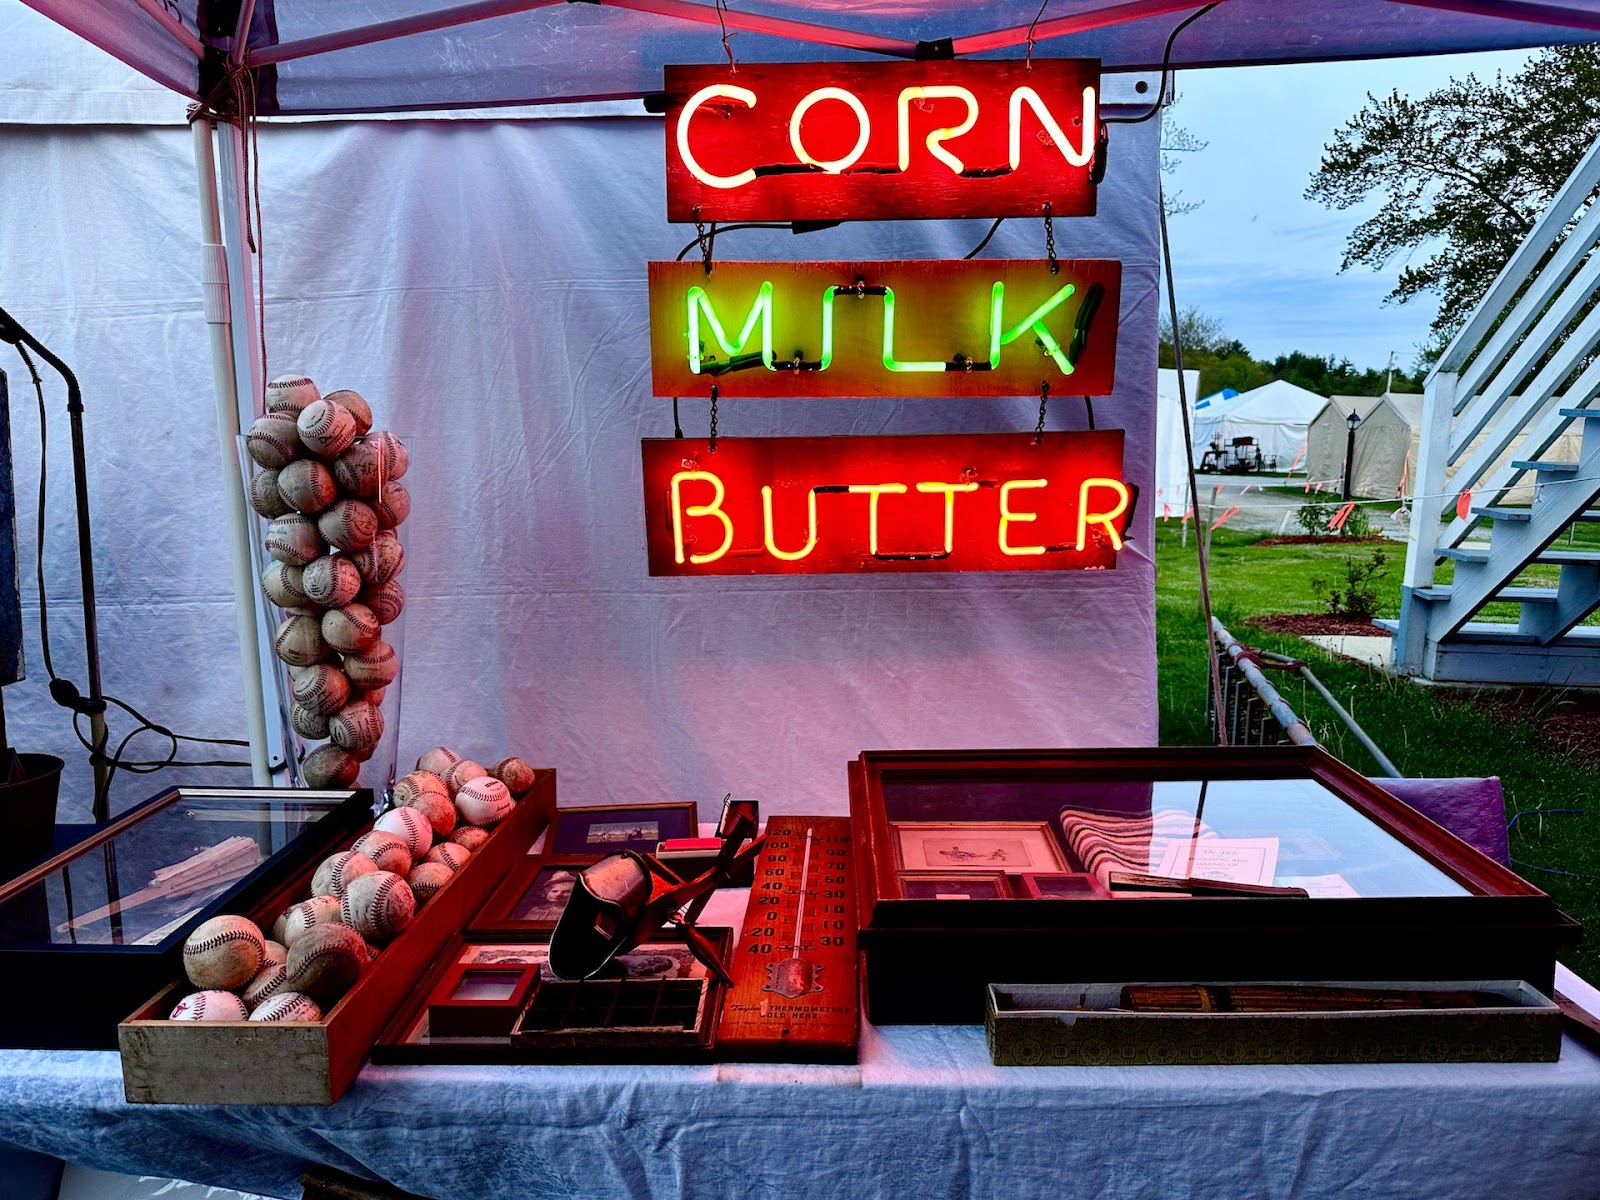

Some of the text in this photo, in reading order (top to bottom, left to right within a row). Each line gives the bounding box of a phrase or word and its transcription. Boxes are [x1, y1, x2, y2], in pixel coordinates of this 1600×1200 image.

[676, 83, 1097, 190] CORN
[686, 280, 1077, 376] MILK
[669, 470, 1130, 565] BUTTER
[826, 835, 849, 843] 110
[764, 841, 790, 849] 100
[827, 848, 846, 857] 90
[767, 854, 787, 863] 80
[827, 863, 845, 871] 70
[764, 868, 785, 877] 60
[825, 875, 845, 884] 50
[761, 881, 783, 890] 40
[823, 889, 845, 899] 30
[758, 896, 781, 906] 20
[824, 904, 845, 913] 10
[766, 911, 778, 921] 0
[823, 920, 844, 929] 10
[751, 927, 775, 937] 20
[820, 935, 844, 946] 30
[747, 943, 773, 954] 40
